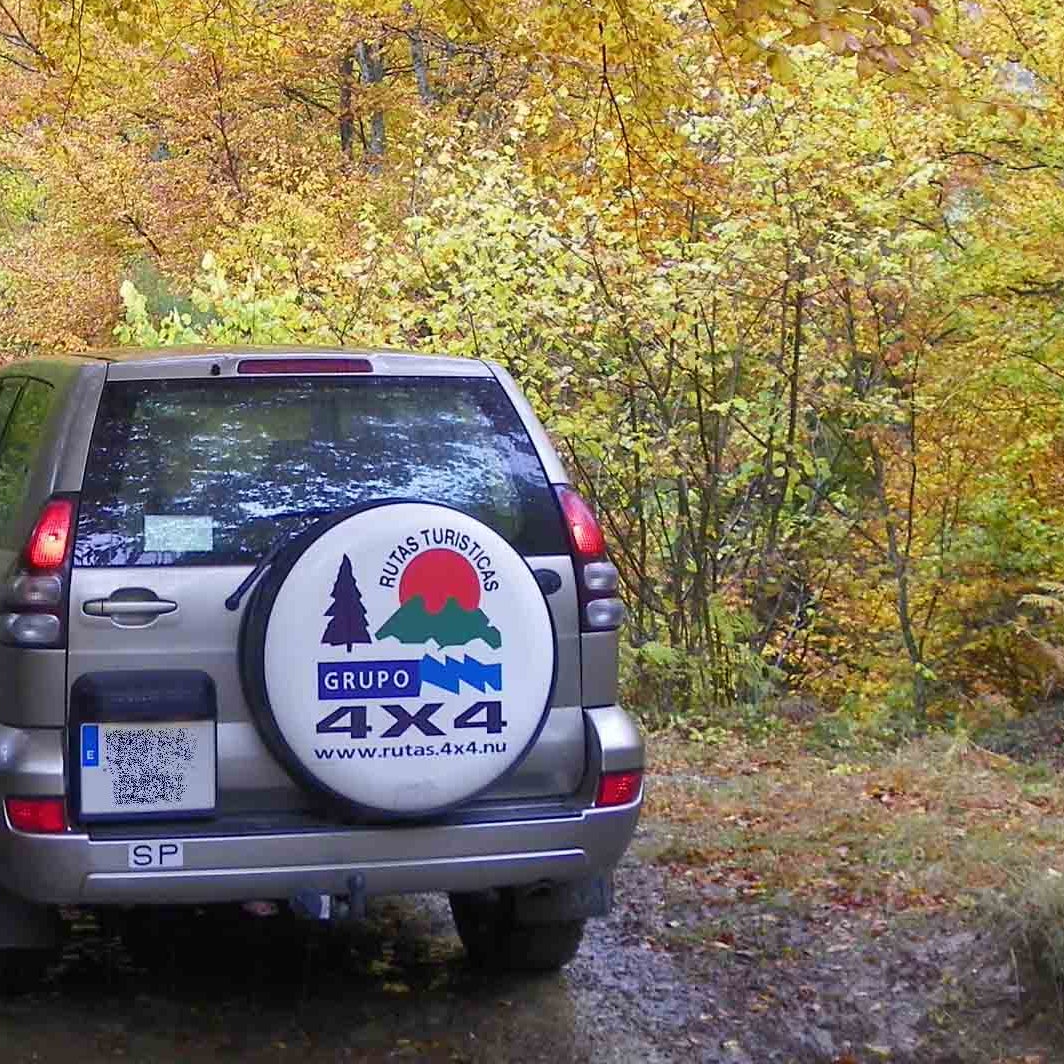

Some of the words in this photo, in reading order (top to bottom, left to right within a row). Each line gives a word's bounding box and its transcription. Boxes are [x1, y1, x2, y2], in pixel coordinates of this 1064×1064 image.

[379, 536, 419, 589] RUTAS
[420, 527, 499, 592] TURISTICAS
[324, 670, 409, 689] GRUPO
[87, 750, 94, 759] E
[315, 741, 507, 759] www.rutas.4x4.nu
[133, 844, 178, 866] SP
